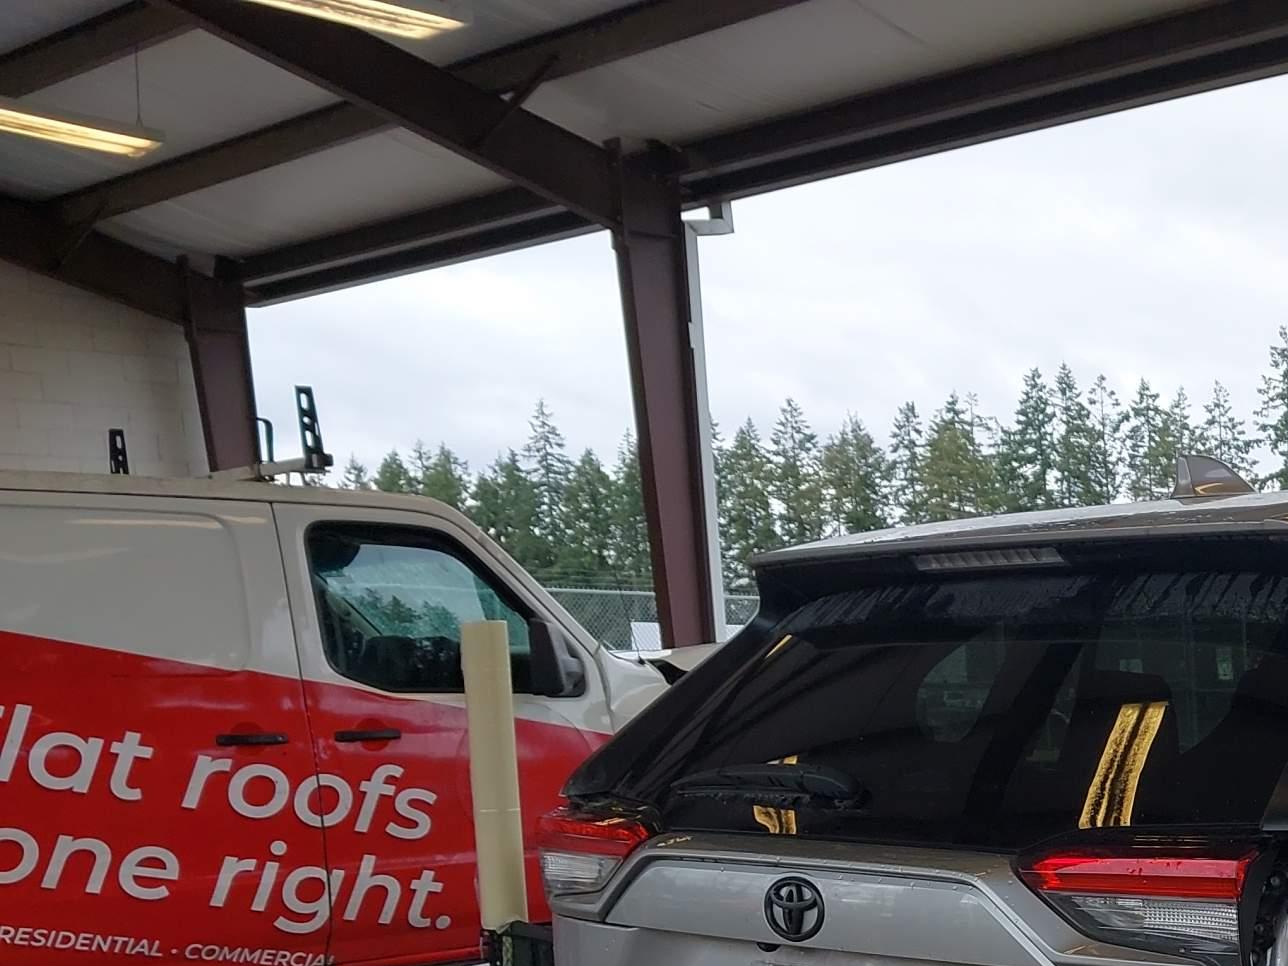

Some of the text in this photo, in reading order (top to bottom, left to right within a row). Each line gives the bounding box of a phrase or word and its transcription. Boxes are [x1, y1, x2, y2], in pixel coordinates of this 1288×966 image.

[0, 703, 438, 840] lat roofs
[209, 840, 452, 934] right.
[0, 926, 163, 957] RESIDENTIAL
